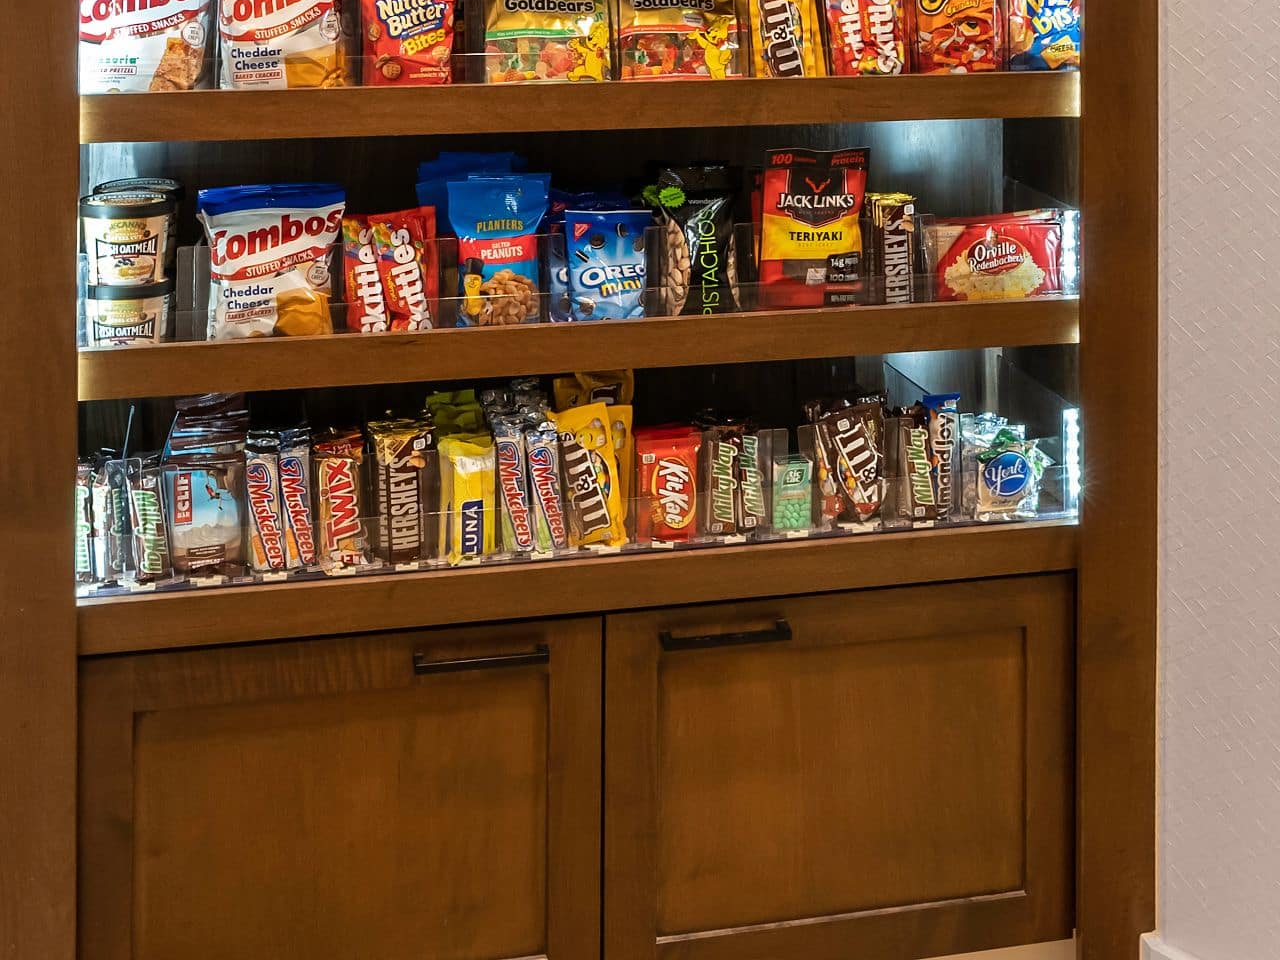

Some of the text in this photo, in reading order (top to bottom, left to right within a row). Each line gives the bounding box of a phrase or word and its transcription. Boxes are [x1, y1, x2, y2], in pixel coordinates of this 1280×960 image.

[945, 0, 982, 17] Crunchy
[152, 13, 185, 31] SNACKS
[254, 7, 321, 40] STUFFED SNACKS
[387, 3, 445, 37] Butter
[231, 47, 282, 59] Cheddar
[403, 29, 446, 57] Bites
[235, 60, 278, 70] Cheese
[772, 154, 792, 165] 100
[777, 193, 855, 209] JACK LINK'S
[476, 218, 523, 233] PLANTERS
[212, 209, 343, 267] Combos
[789, 231, 843, 241] TERIYAKI
[119, 241, 156, 256] OATMEAL
[480, 246, 523, 260] PEANUTS
[974, 242, 1017, 262] Orville
[246, 250, 314, 277] STUFFED SNACKS
[703, 209, 718, 315] PISTACHIOS
[884, 220, 907, 304] HERSHEY'S
[968, 253, 1024, 273] Redenbacher's
[581, 264, 646, 287] OREO
[223, 286, 274, 299] Cheddar
[600, 277, 642, 298] mini
[227, 299, 270, 310] Cheese
[117, 326, 153, 338] OATMEAL
[326, 460, 360, 549] TWIX
[390, 456, 420, 552] HERSHEY'S
[499, 461, 532, 548] Musketeers
[248, 481, 283, 569] Musketeers
[281, 475, 314, 564] Musketeers
[463, 505, 480, 554] LUNA
